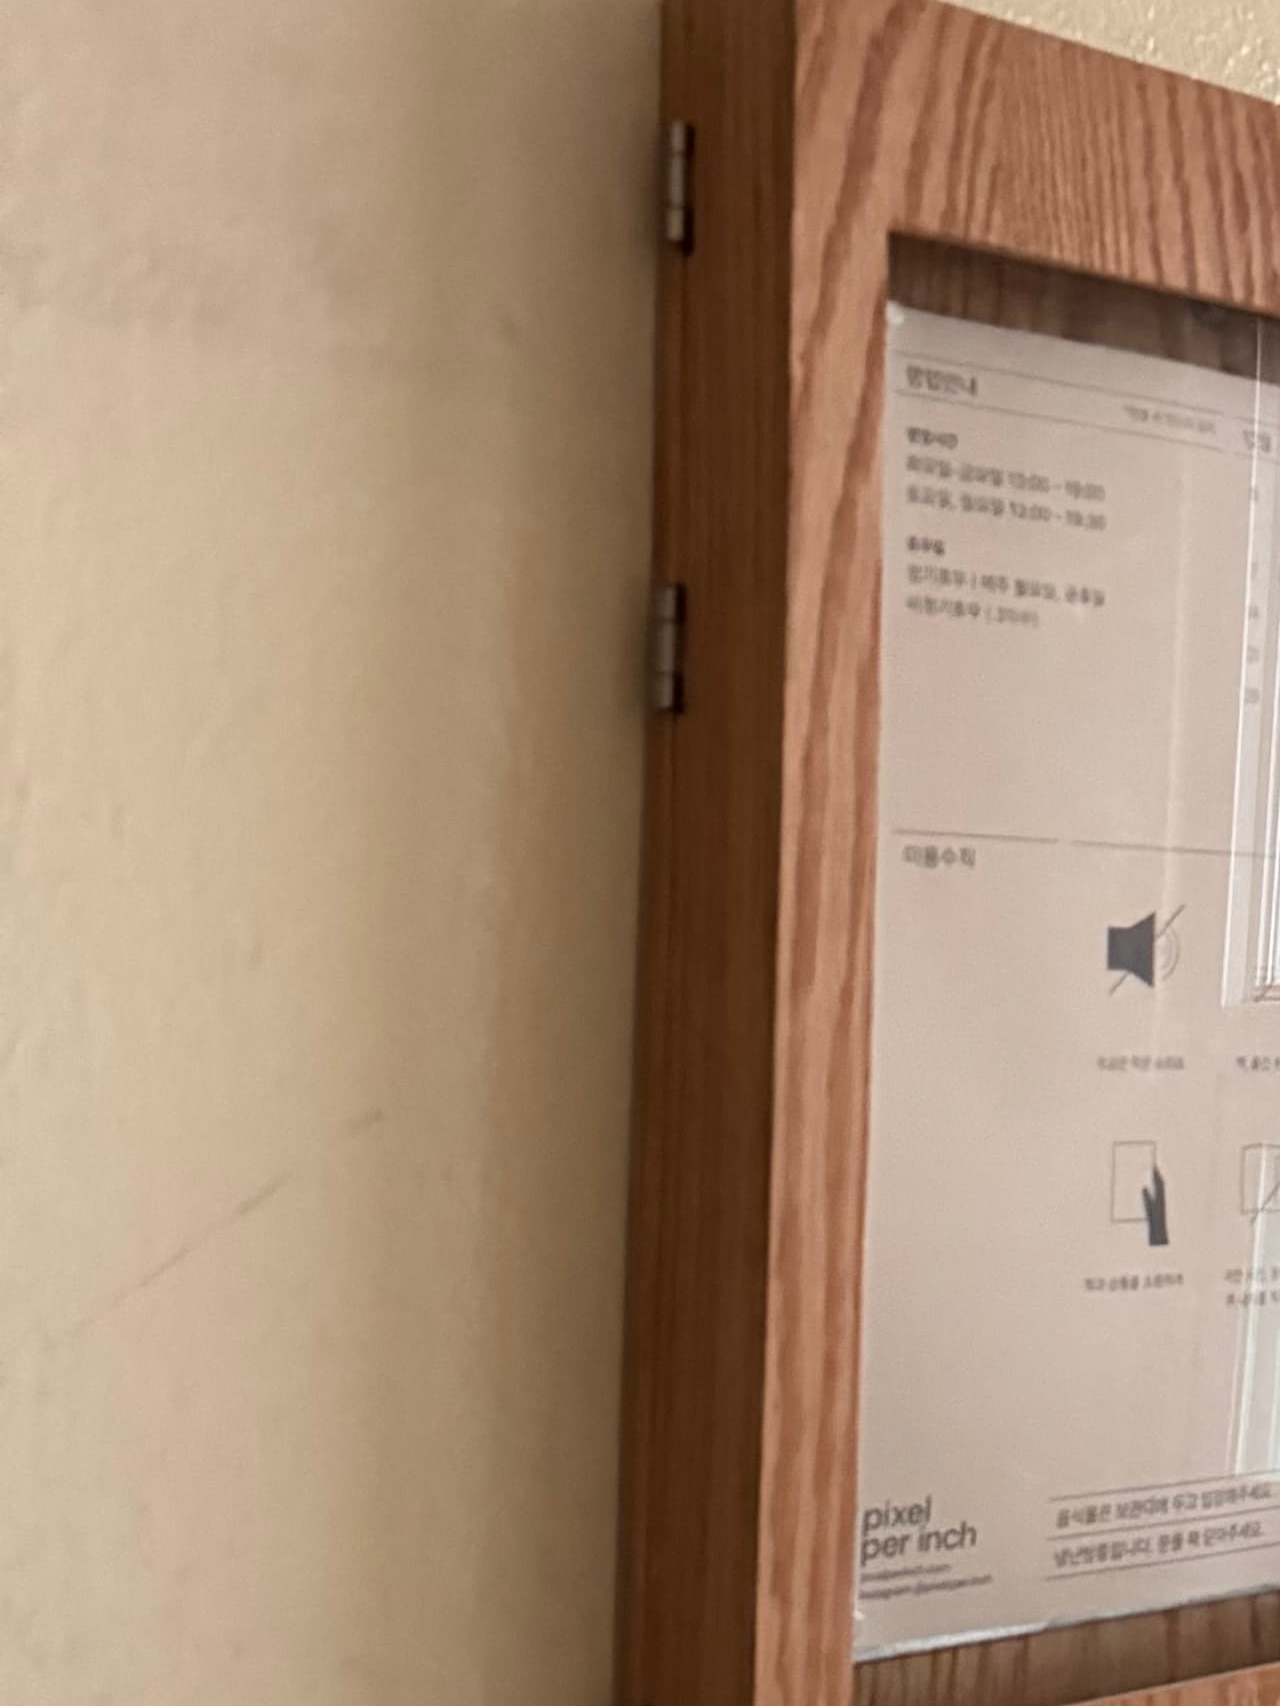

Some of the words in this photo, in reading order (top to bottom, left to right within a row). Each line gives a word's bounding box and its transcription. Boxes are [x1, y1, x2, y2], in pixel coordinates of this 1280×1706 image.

[861, 1495, 932, 1537] pixel
[859, 1532, 911, 1568] per
[916, 1520, 977, 1554] inch
